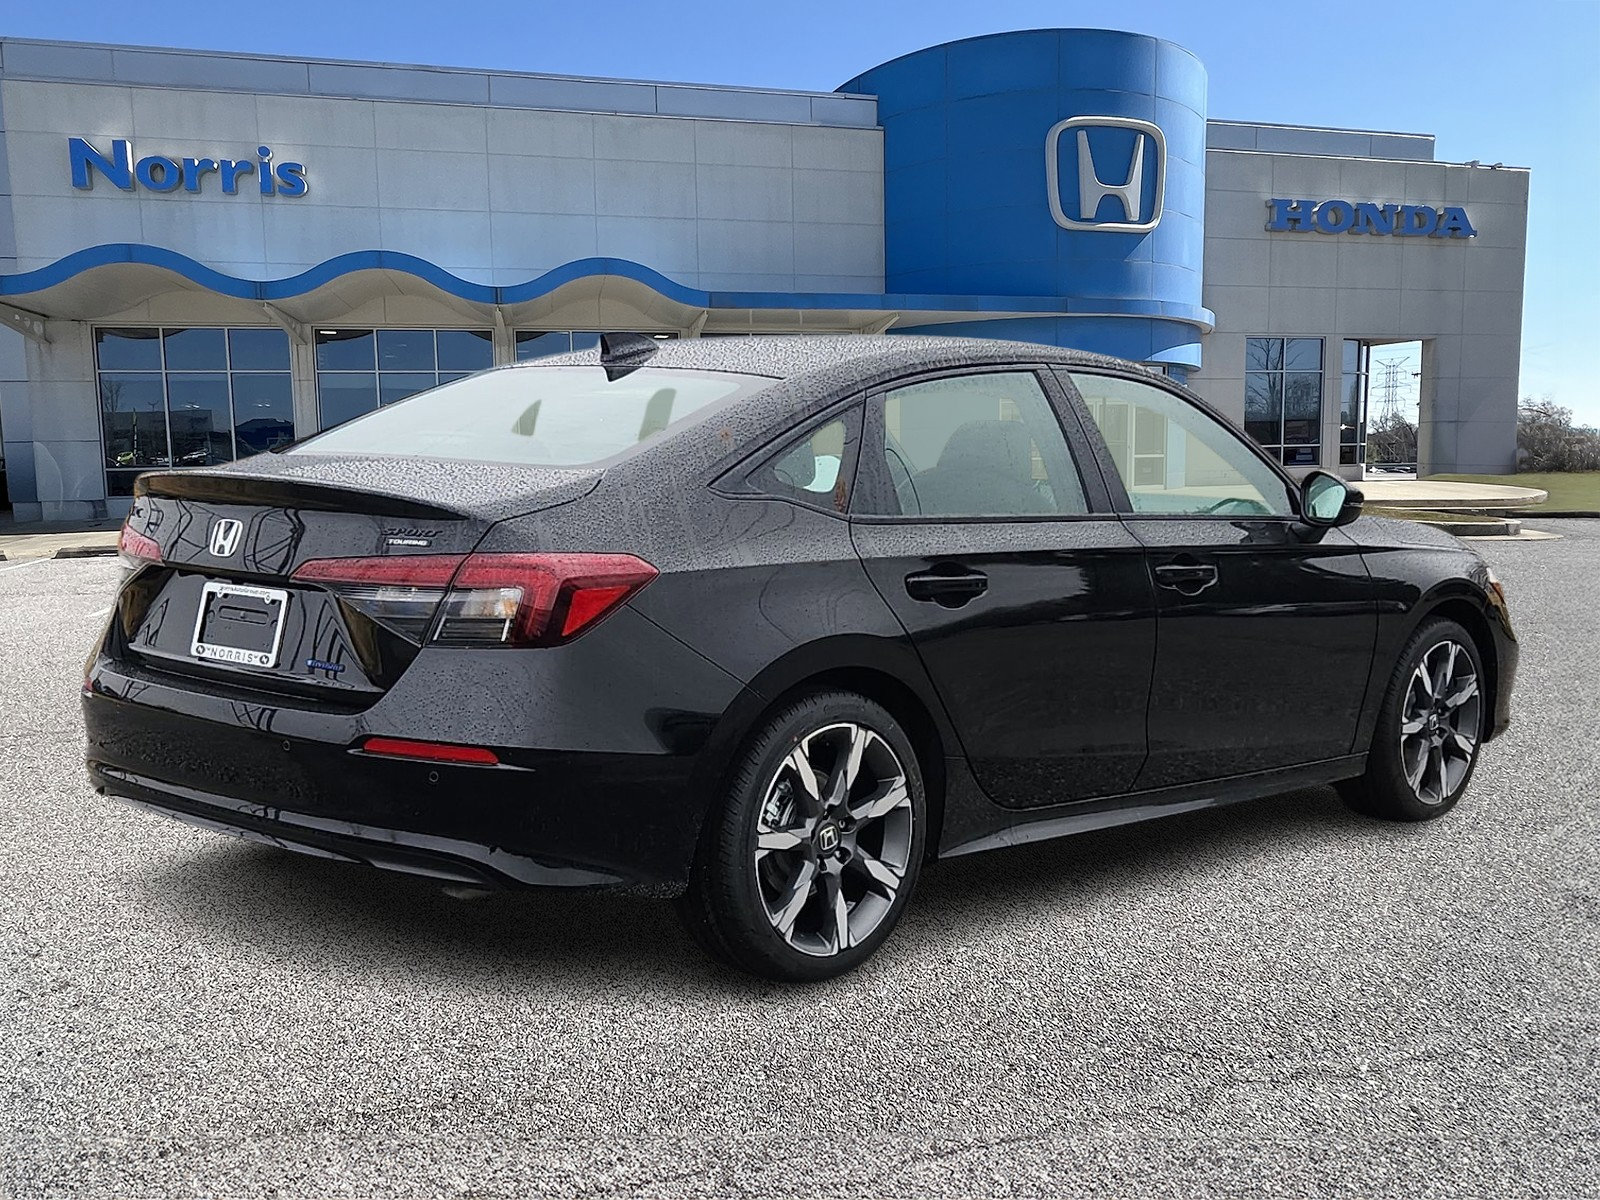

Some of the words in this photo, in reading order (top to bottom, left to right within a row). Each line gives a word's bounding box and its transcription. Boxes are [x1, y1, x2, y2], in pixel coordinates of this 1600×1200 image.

[68, 137, 309, 198] Norris
[1266, 199, 1478, 239] HONDA
[388, 538, 429, 546] TOURING
[211, 648, 253, 662] NORRIS
